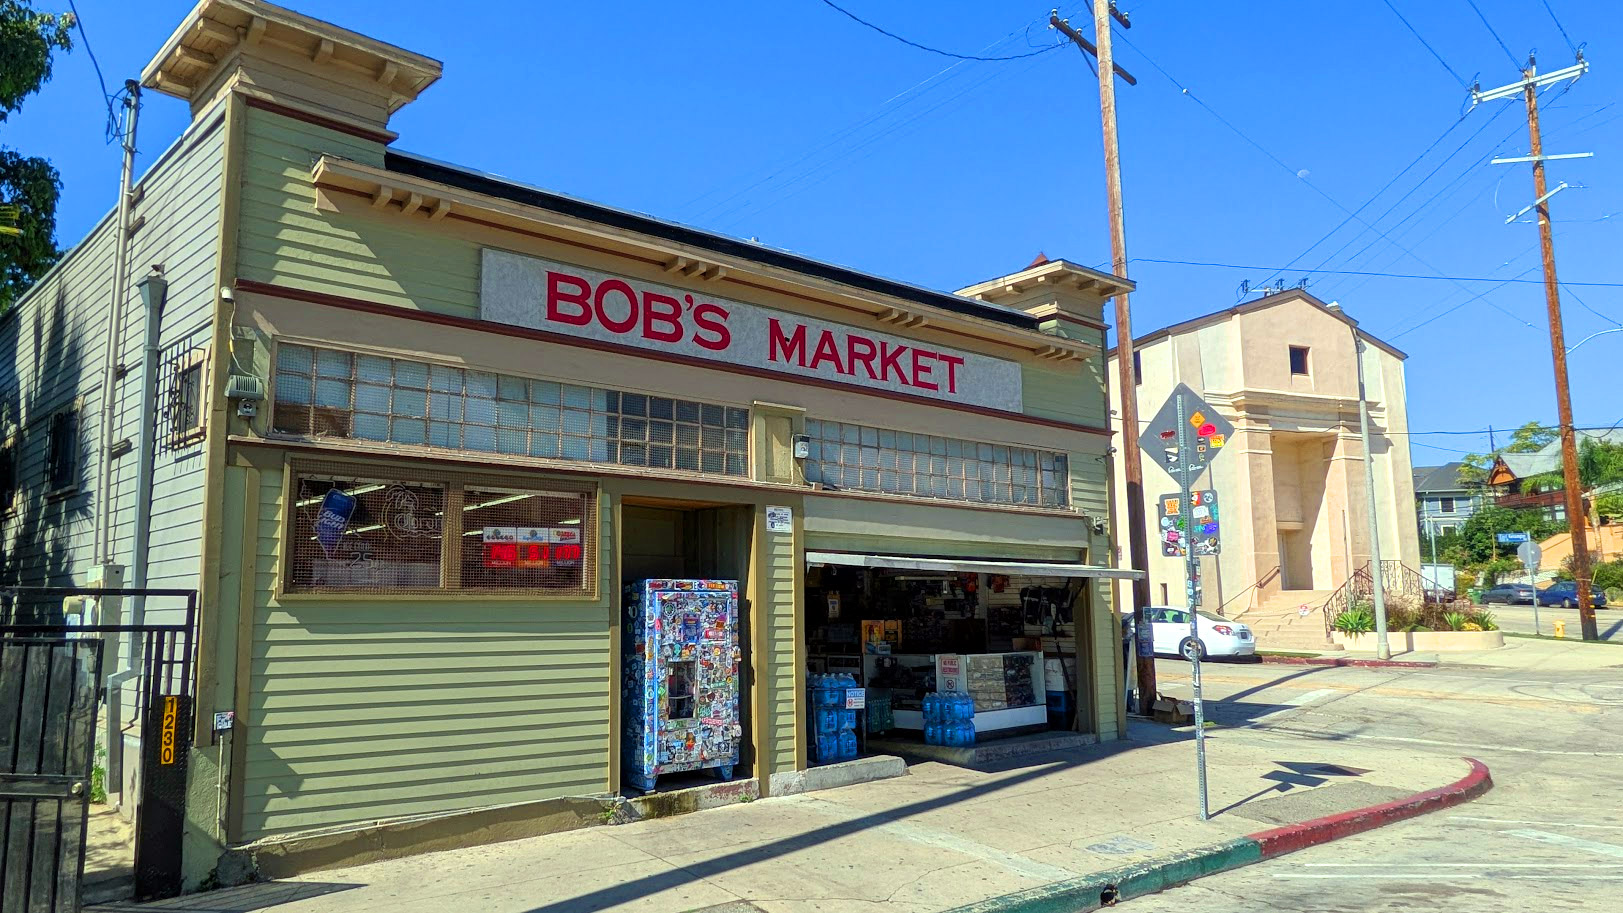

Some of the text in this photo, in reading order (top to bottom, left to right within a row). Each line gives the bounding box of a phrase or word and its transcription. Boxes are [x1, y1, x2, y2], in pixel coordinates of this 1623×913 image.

[546, 270, 965, 394] BOB'S MARKET
[323, 510, 346, 522] BUD
[162, 697, 175, 763] 1230
